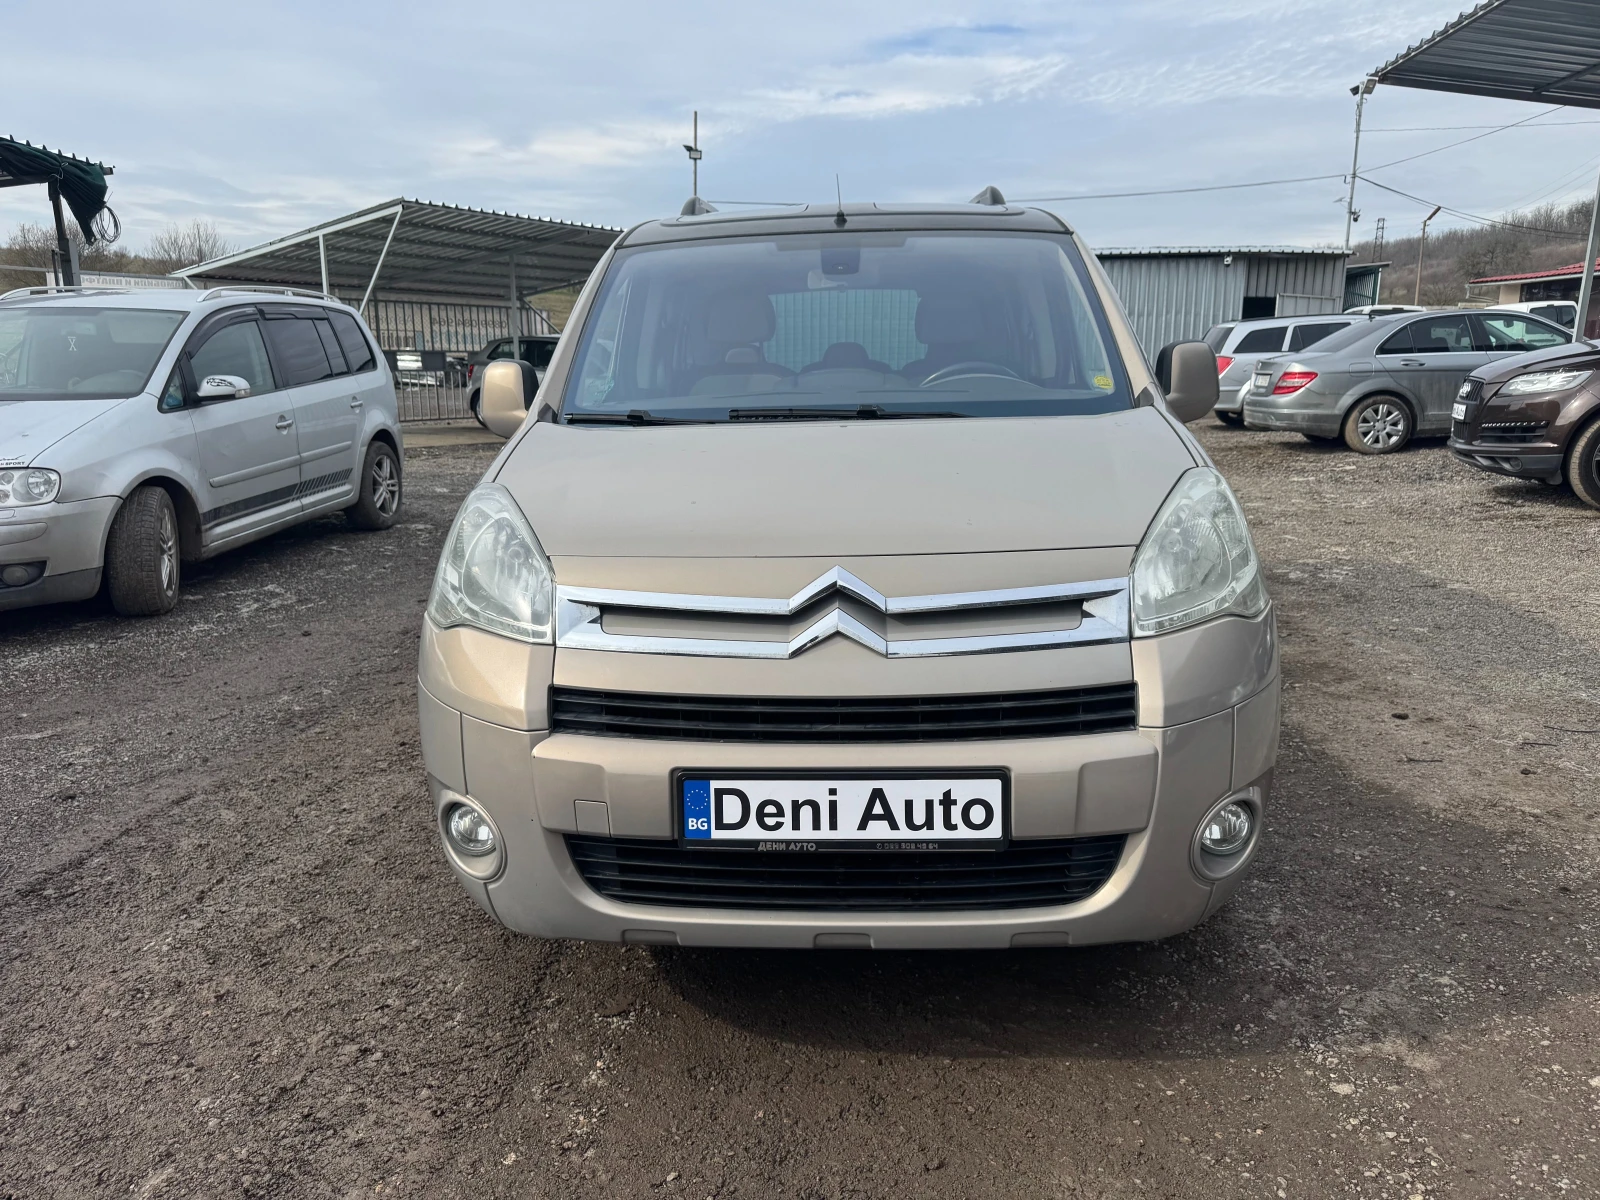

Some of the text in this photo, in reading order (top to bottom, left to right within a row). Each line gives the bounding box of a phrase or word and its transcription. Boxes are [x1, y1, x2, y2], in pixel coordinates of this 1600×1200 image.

[713, 787, 995, 832] Deni Auto
[688, 818, 708, 831] BG
[757, 841, 816, 851] ДЕНИ АУТО
